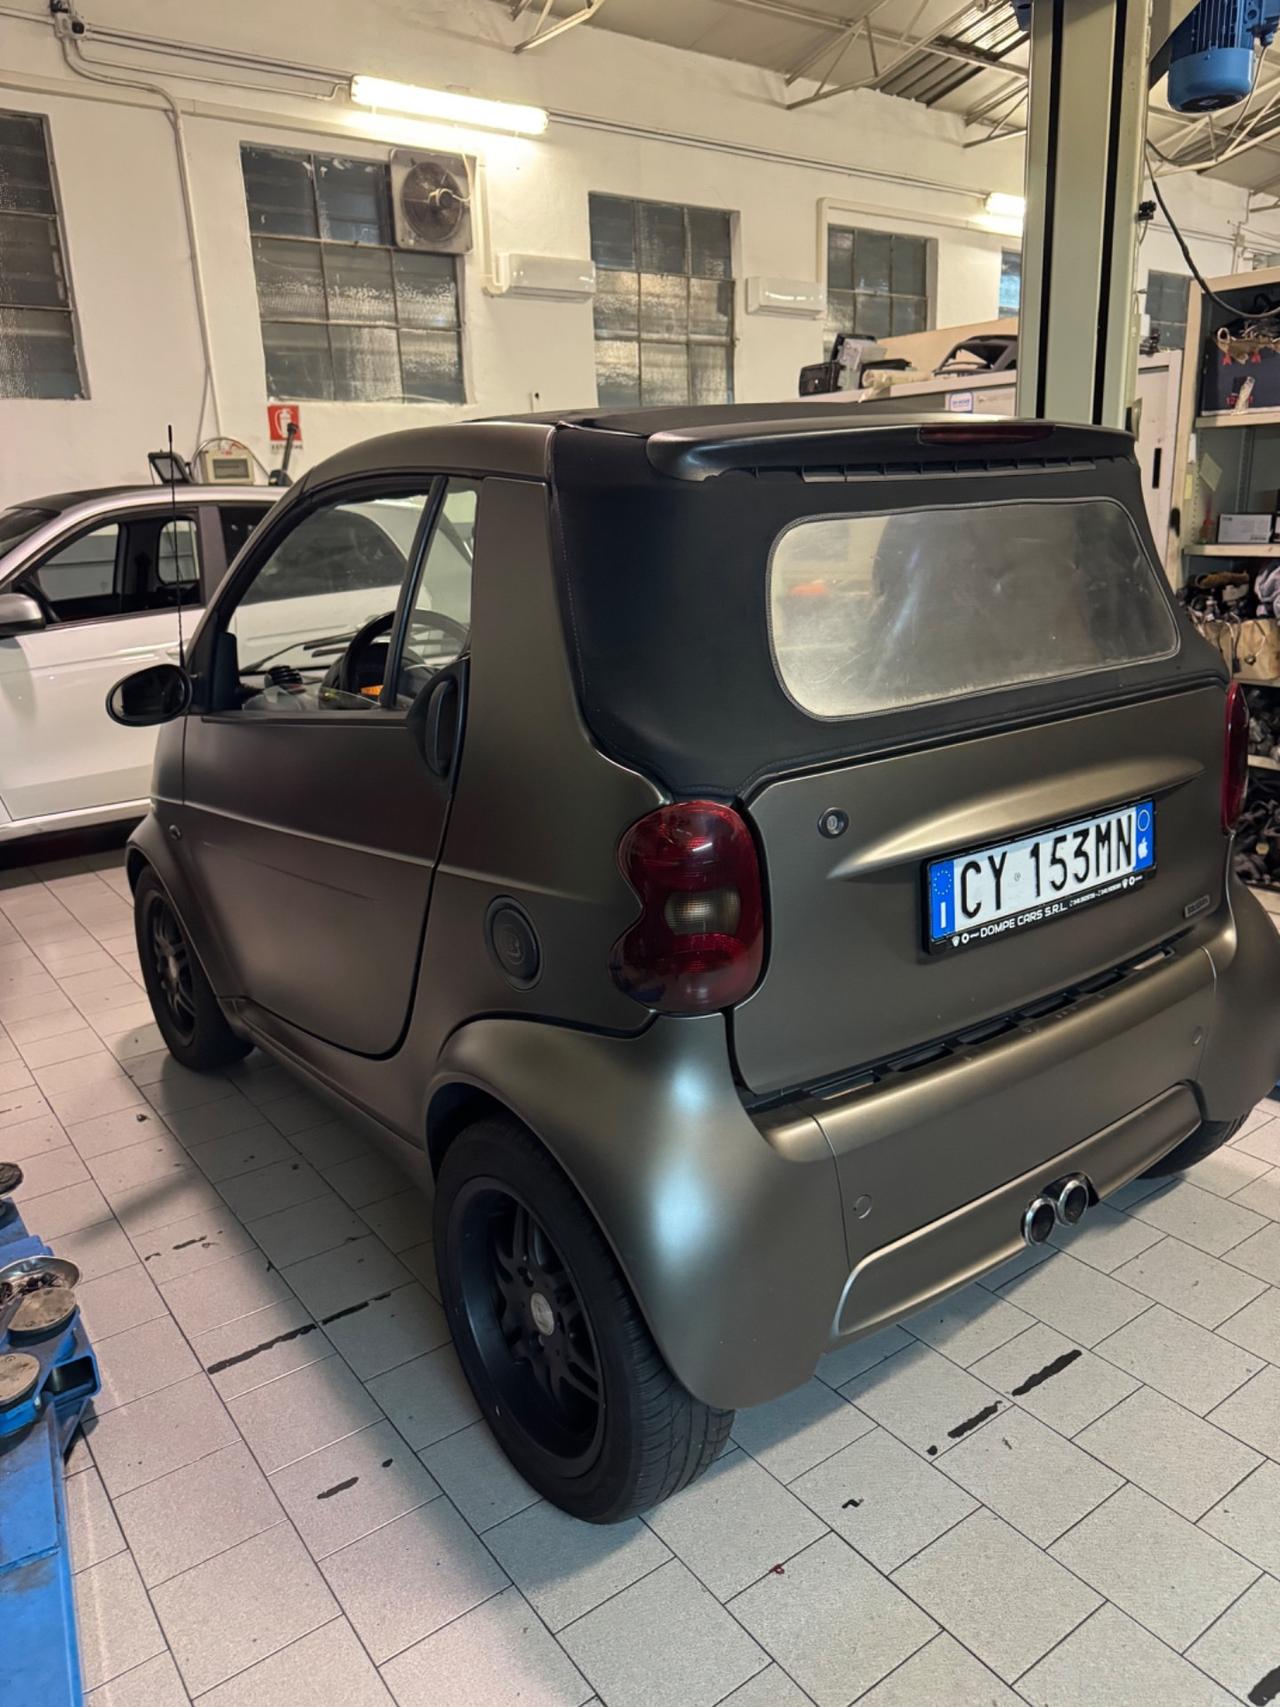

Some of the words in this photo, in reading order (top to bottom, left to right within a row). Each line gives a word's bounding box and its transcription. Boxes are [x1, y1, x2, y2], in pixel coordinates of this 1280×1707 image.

[960, 851, 1008, 918] CY
[940, 902, 946, 928] I
[980, 918, 1016, 938] DOMPE
[1017, 909, 1043, 926] CARS
